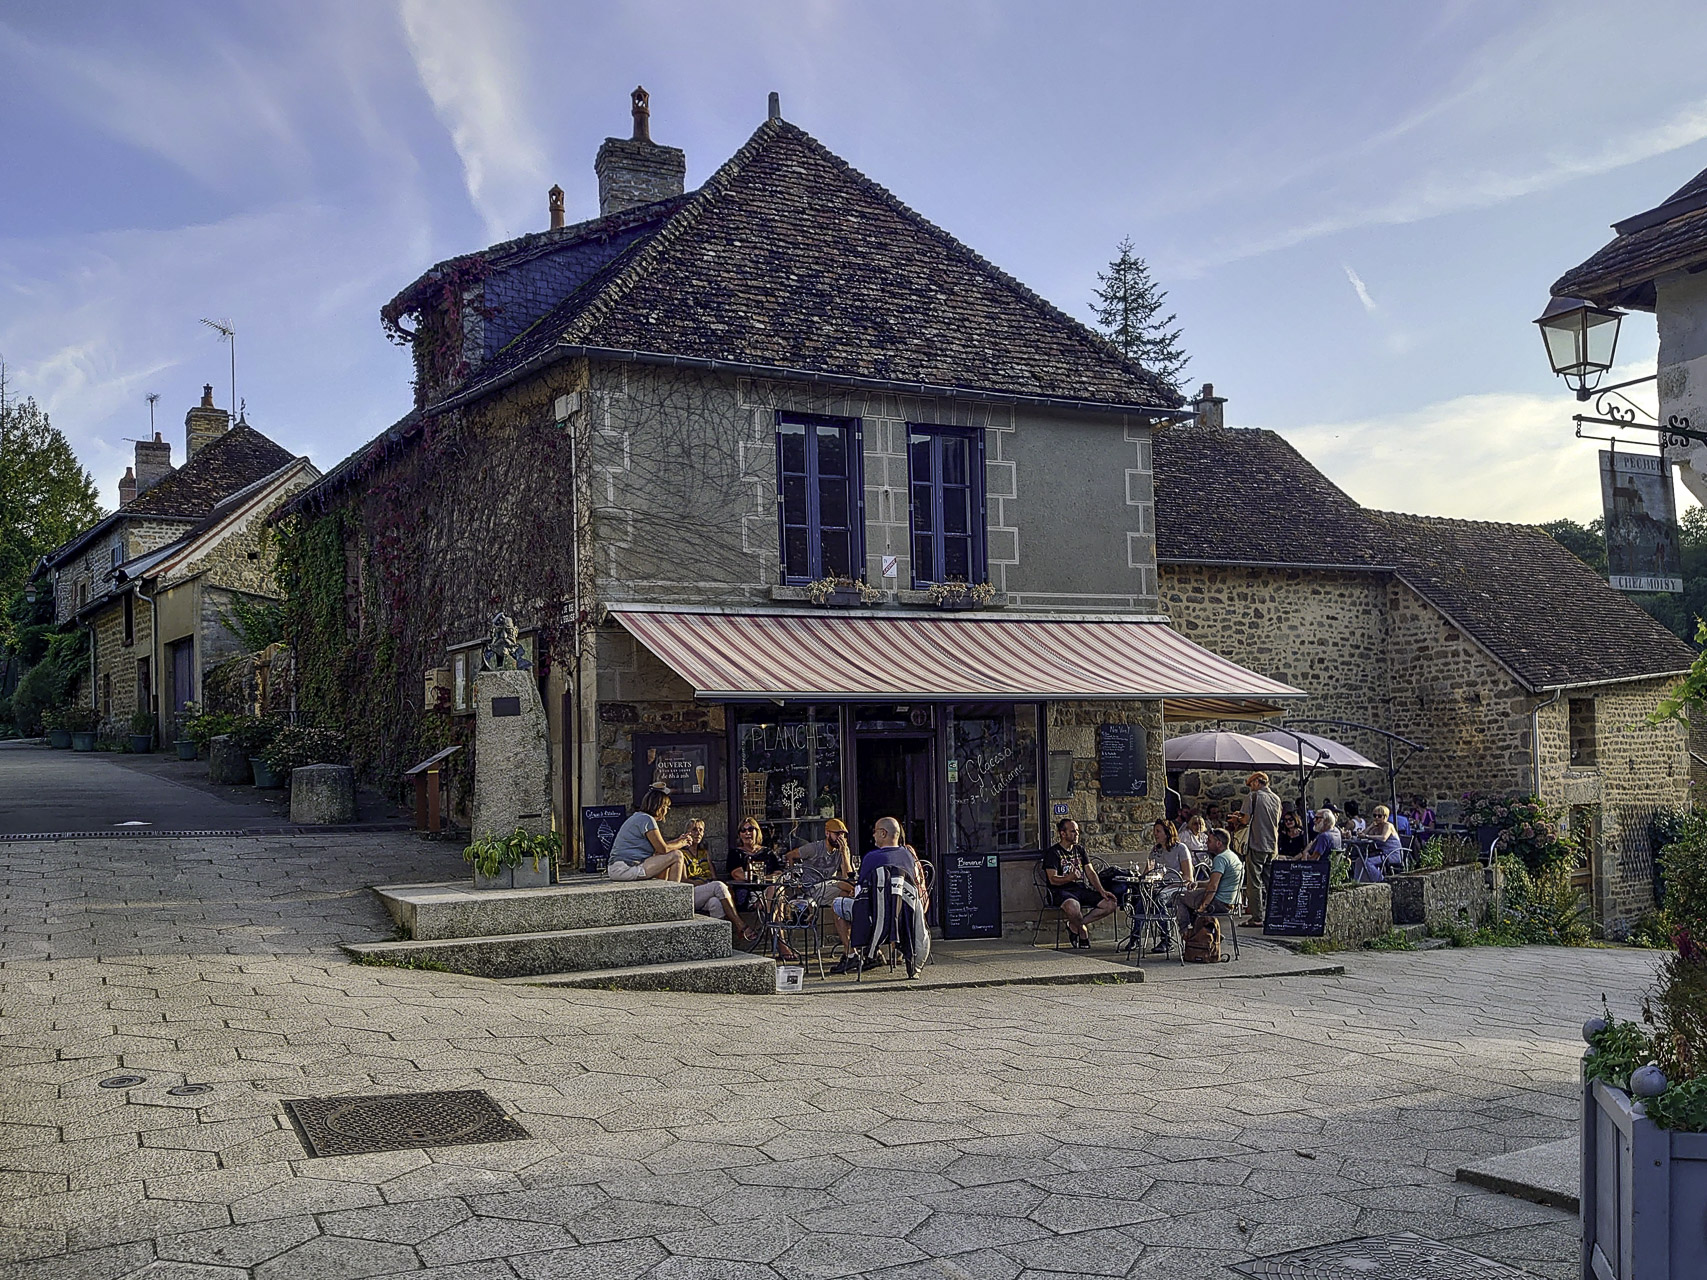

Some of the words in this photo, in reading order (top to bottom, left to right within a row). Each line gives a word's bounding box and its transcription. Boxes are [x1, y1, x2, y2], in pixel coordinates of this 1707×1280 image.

[1618, 576, 1643, 589] CHEZ
[1646, 578, 1676, 591] MOISY
[751, 723, 836, 751] PLANCHES
[657, 761, 692, 769] OUVERTS
[965, 754, 1005, 788] Glaces
